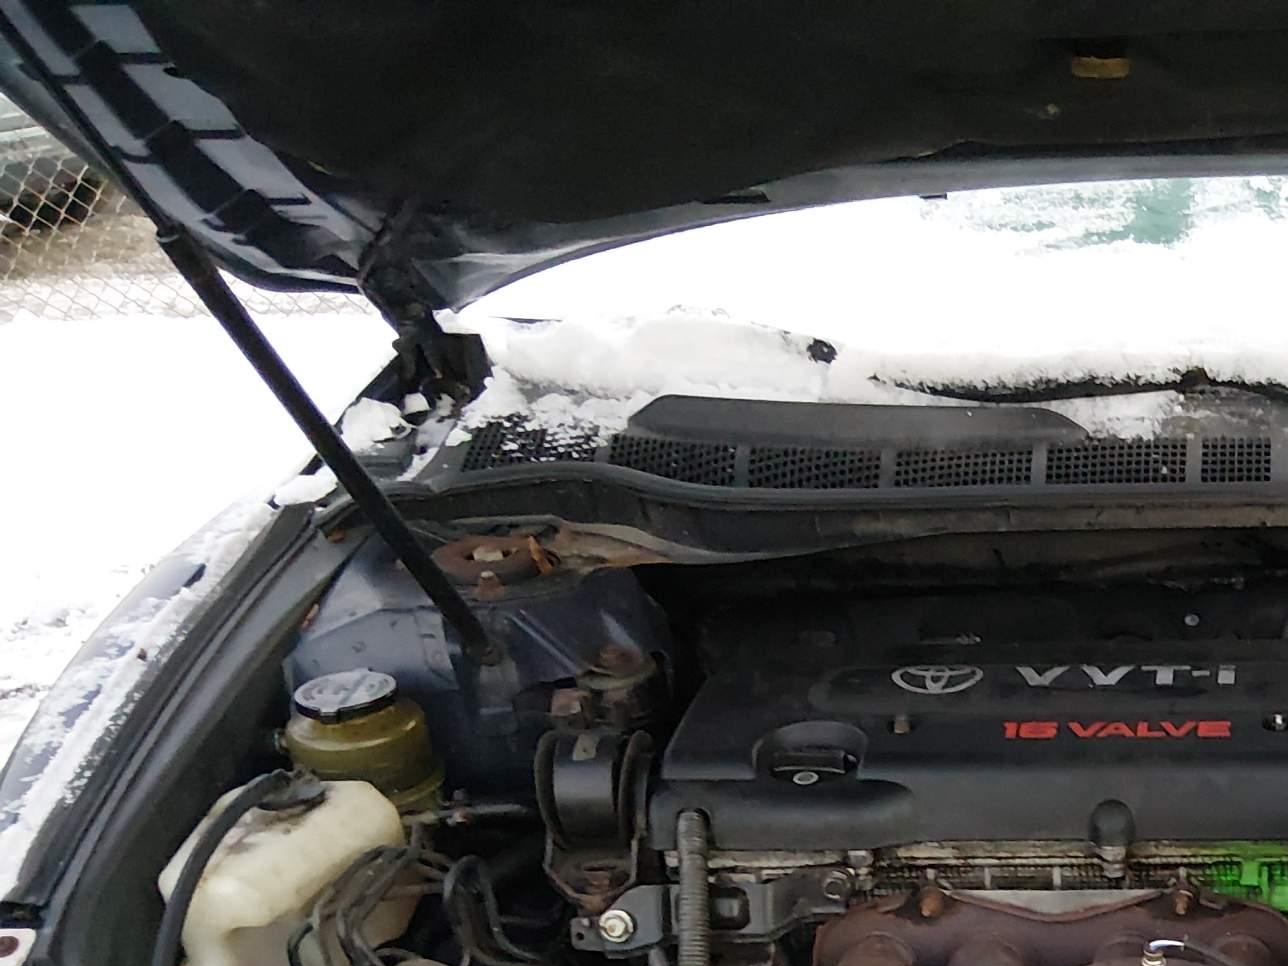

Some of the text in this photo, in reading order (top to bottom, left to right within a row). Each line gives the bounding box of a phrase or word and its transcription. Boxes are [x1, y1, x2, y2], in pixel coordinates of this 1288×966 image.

[1015, 664, 1236, 686] VVT-i
[1003, 721, 1232, 738] 16 VALVE
